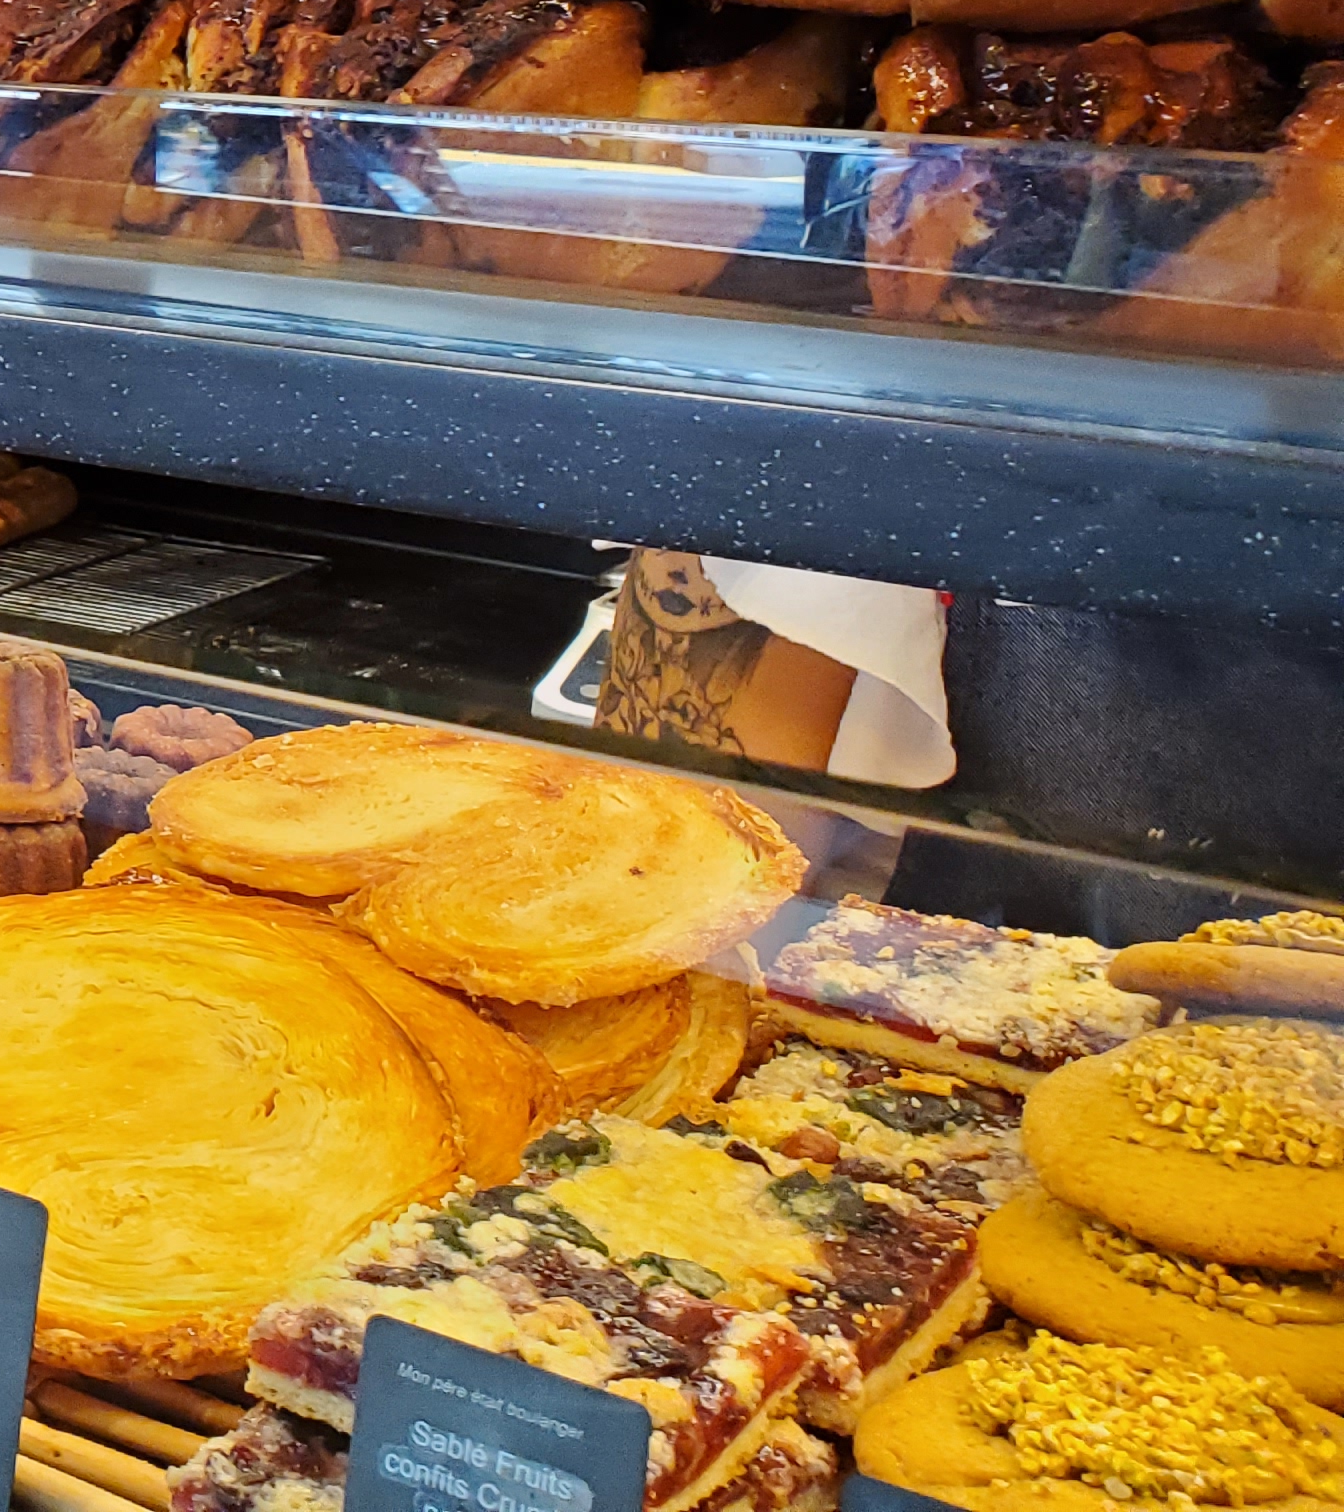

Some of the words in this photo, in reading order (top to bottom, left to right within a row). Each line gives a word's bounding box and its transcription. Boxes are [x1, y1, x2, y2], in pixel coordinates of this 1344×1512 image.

[397, 1361, 431, 1386] Mon
[384, 1452, 470, 1500] confits
[412, 1420, 488, 1468] Sablé
[496, 1450, 573, 1501] Fruits
